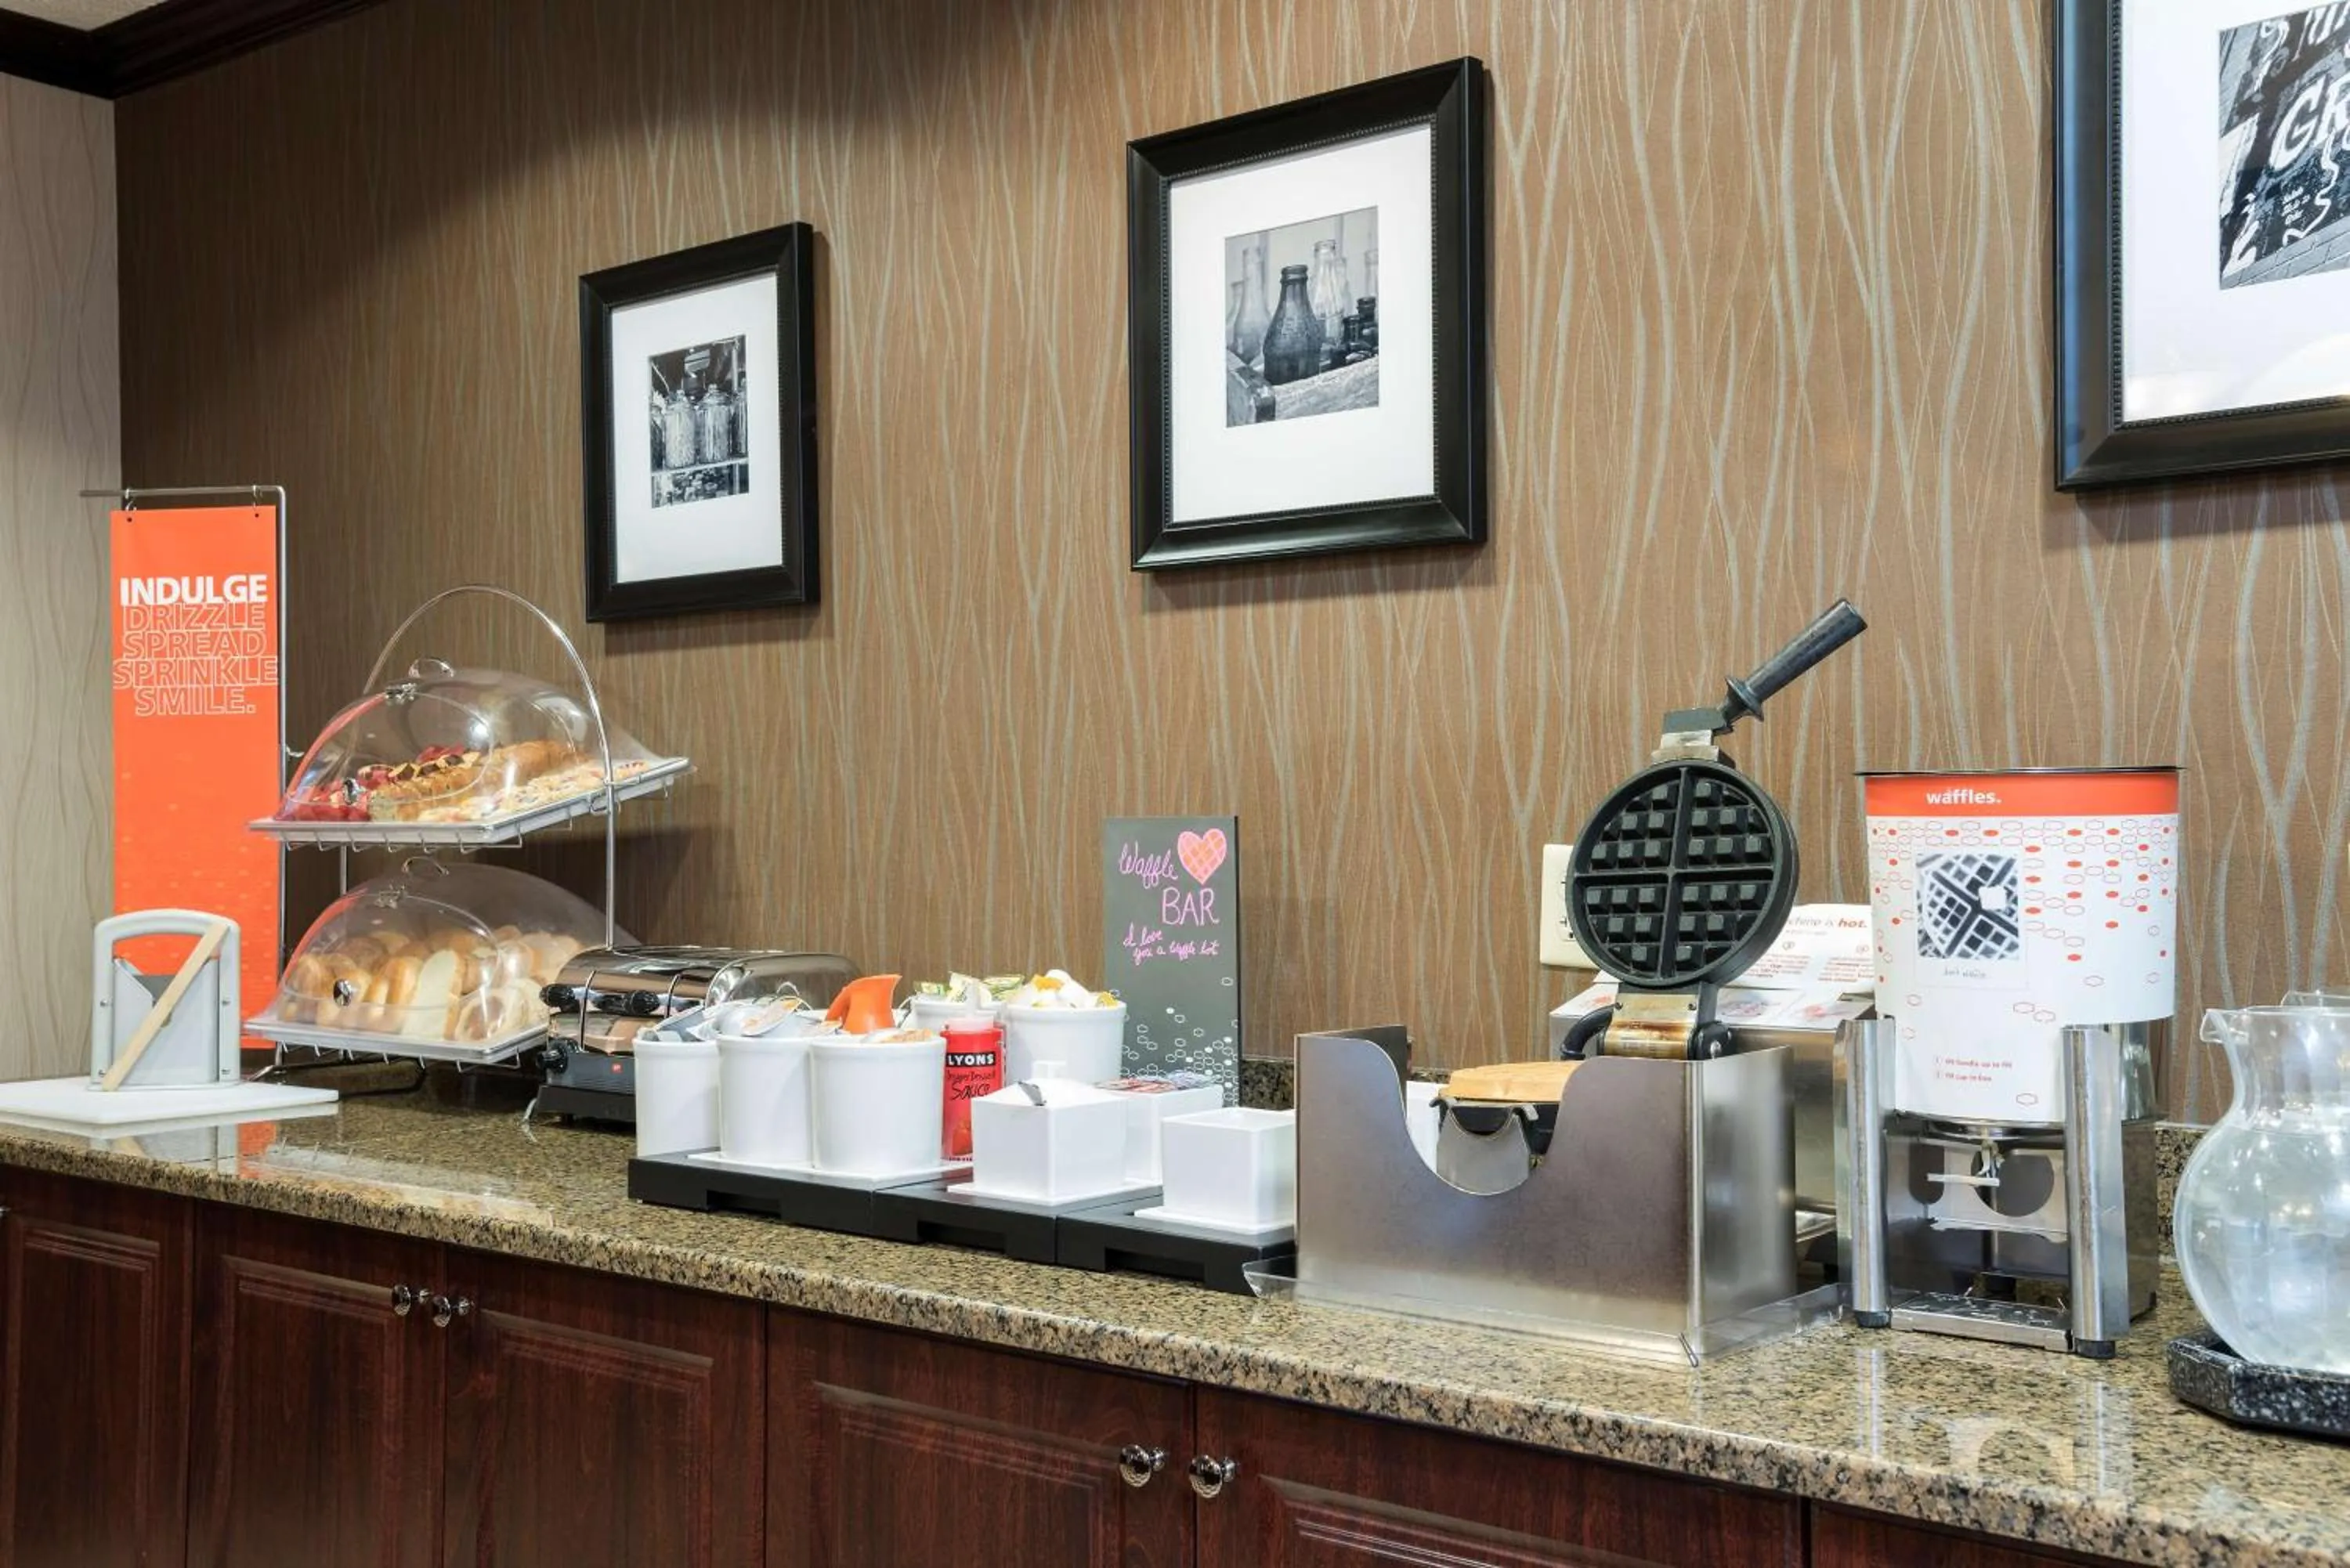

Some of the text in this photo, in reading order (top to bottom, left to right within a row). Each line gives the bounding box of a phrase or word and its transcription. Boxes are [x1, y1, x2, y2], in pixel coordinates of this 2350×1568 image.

[120, 574, 268, 606] INDULGE
[122, 602, 266, 631] DRIZZLE
[122, 629, 267, 659] SPREAD
[113, 656, 279, 689] SPRINKLE
[135, 685, 256, 717] SMILE.
[1926, 788, 2002, 805] waffles.
[1119, 840, 1178, 889] Waffle
[1162, 887, 1220, 927] BAR
[1140, 926, 1163, 947] love
[1838, 917, 1867, 929] hot.
[1133, 946, 1153, 966] you
[1156, 946, 1166, 955] a
[947, 1053, 995, 1066] LYONS
